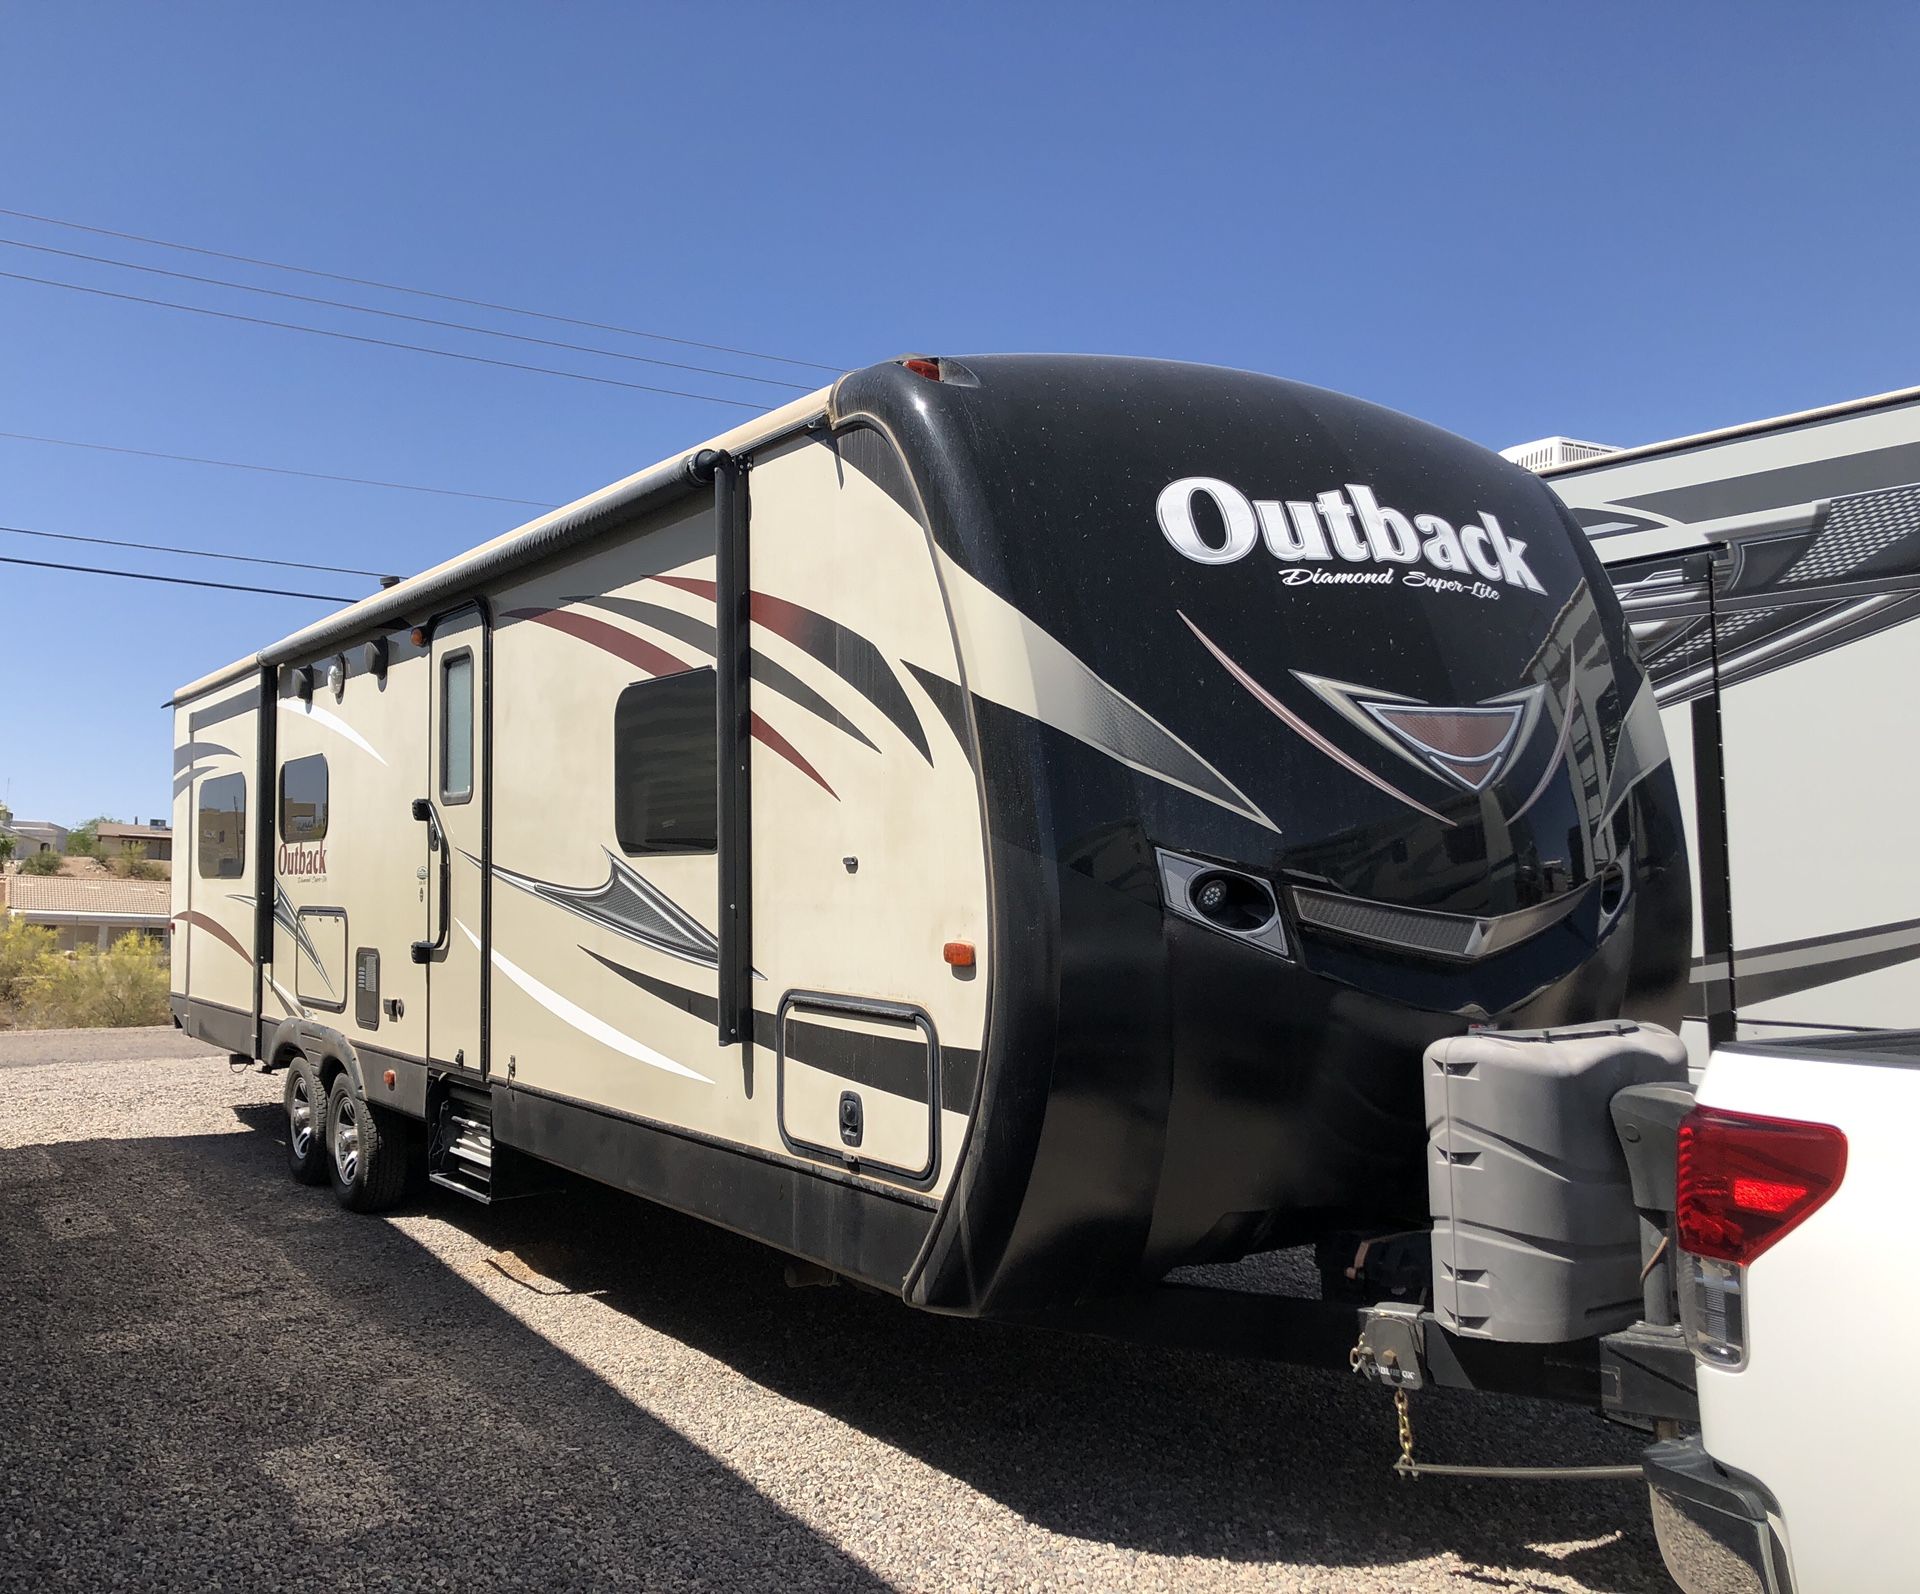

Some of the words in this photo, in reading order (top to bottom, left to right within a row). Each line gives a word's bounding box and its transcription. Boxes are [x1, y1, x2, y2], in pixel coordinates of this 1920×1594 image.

[1156, 476, 1548, 596] Outback
[1278, 567, 1394, 586] Diamond
[1402, 571, 1500, 600] Super-Lite
[278, 840, 327, 875] Outback
